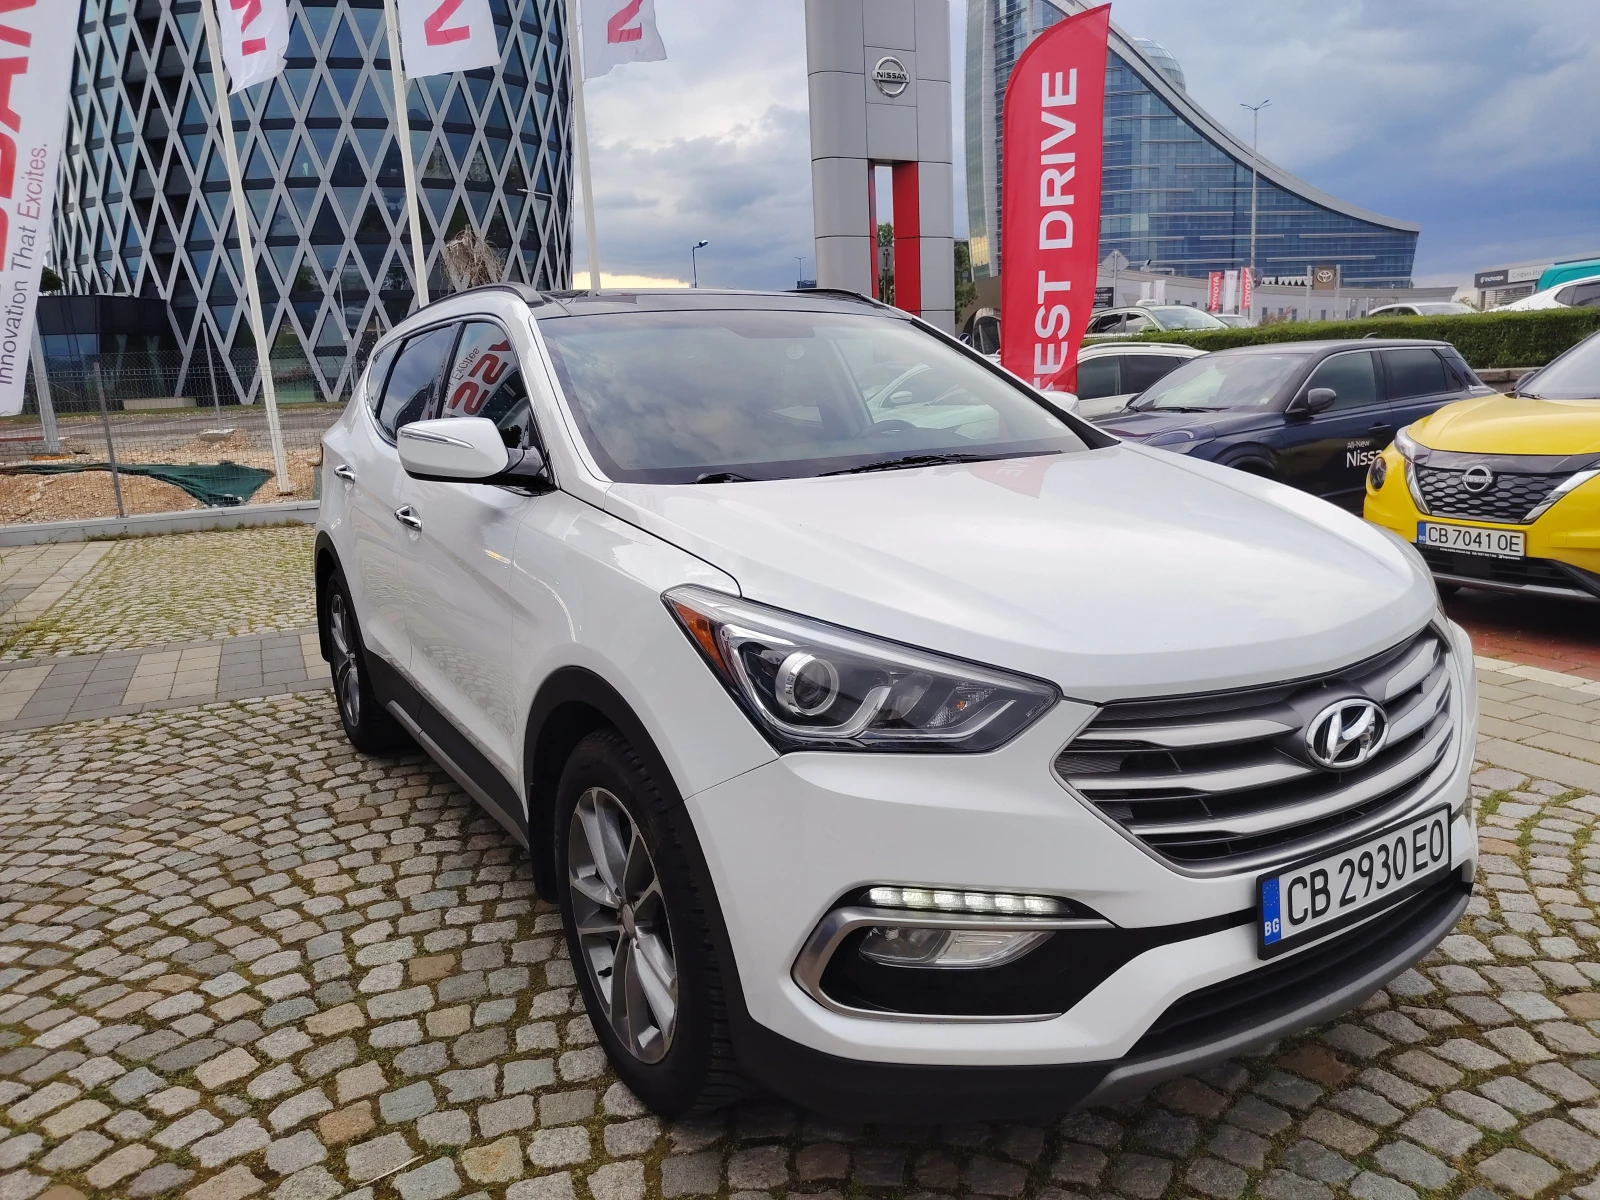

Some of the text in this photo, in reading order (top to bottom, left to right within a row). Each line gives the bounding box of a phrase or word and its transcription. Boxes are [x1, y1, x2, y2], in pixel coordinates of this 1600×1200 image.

[876, 71, 907, 81] NISSAN
[1039, 68, 1077, 250] DRIVE
[17, 143, 48, 220] Excites.
[11, 225, 37, 271] That
[1211, 276, 1220, 309] TOYOTA
[1347, 440, 1370, 449] All-New
[1452, 529, 1492, 550] 7041
[1286, 869, 1332, 927] CB
[1338, 835, 1407, 909] 2930
[1264, 916, 1280, 938] BG
